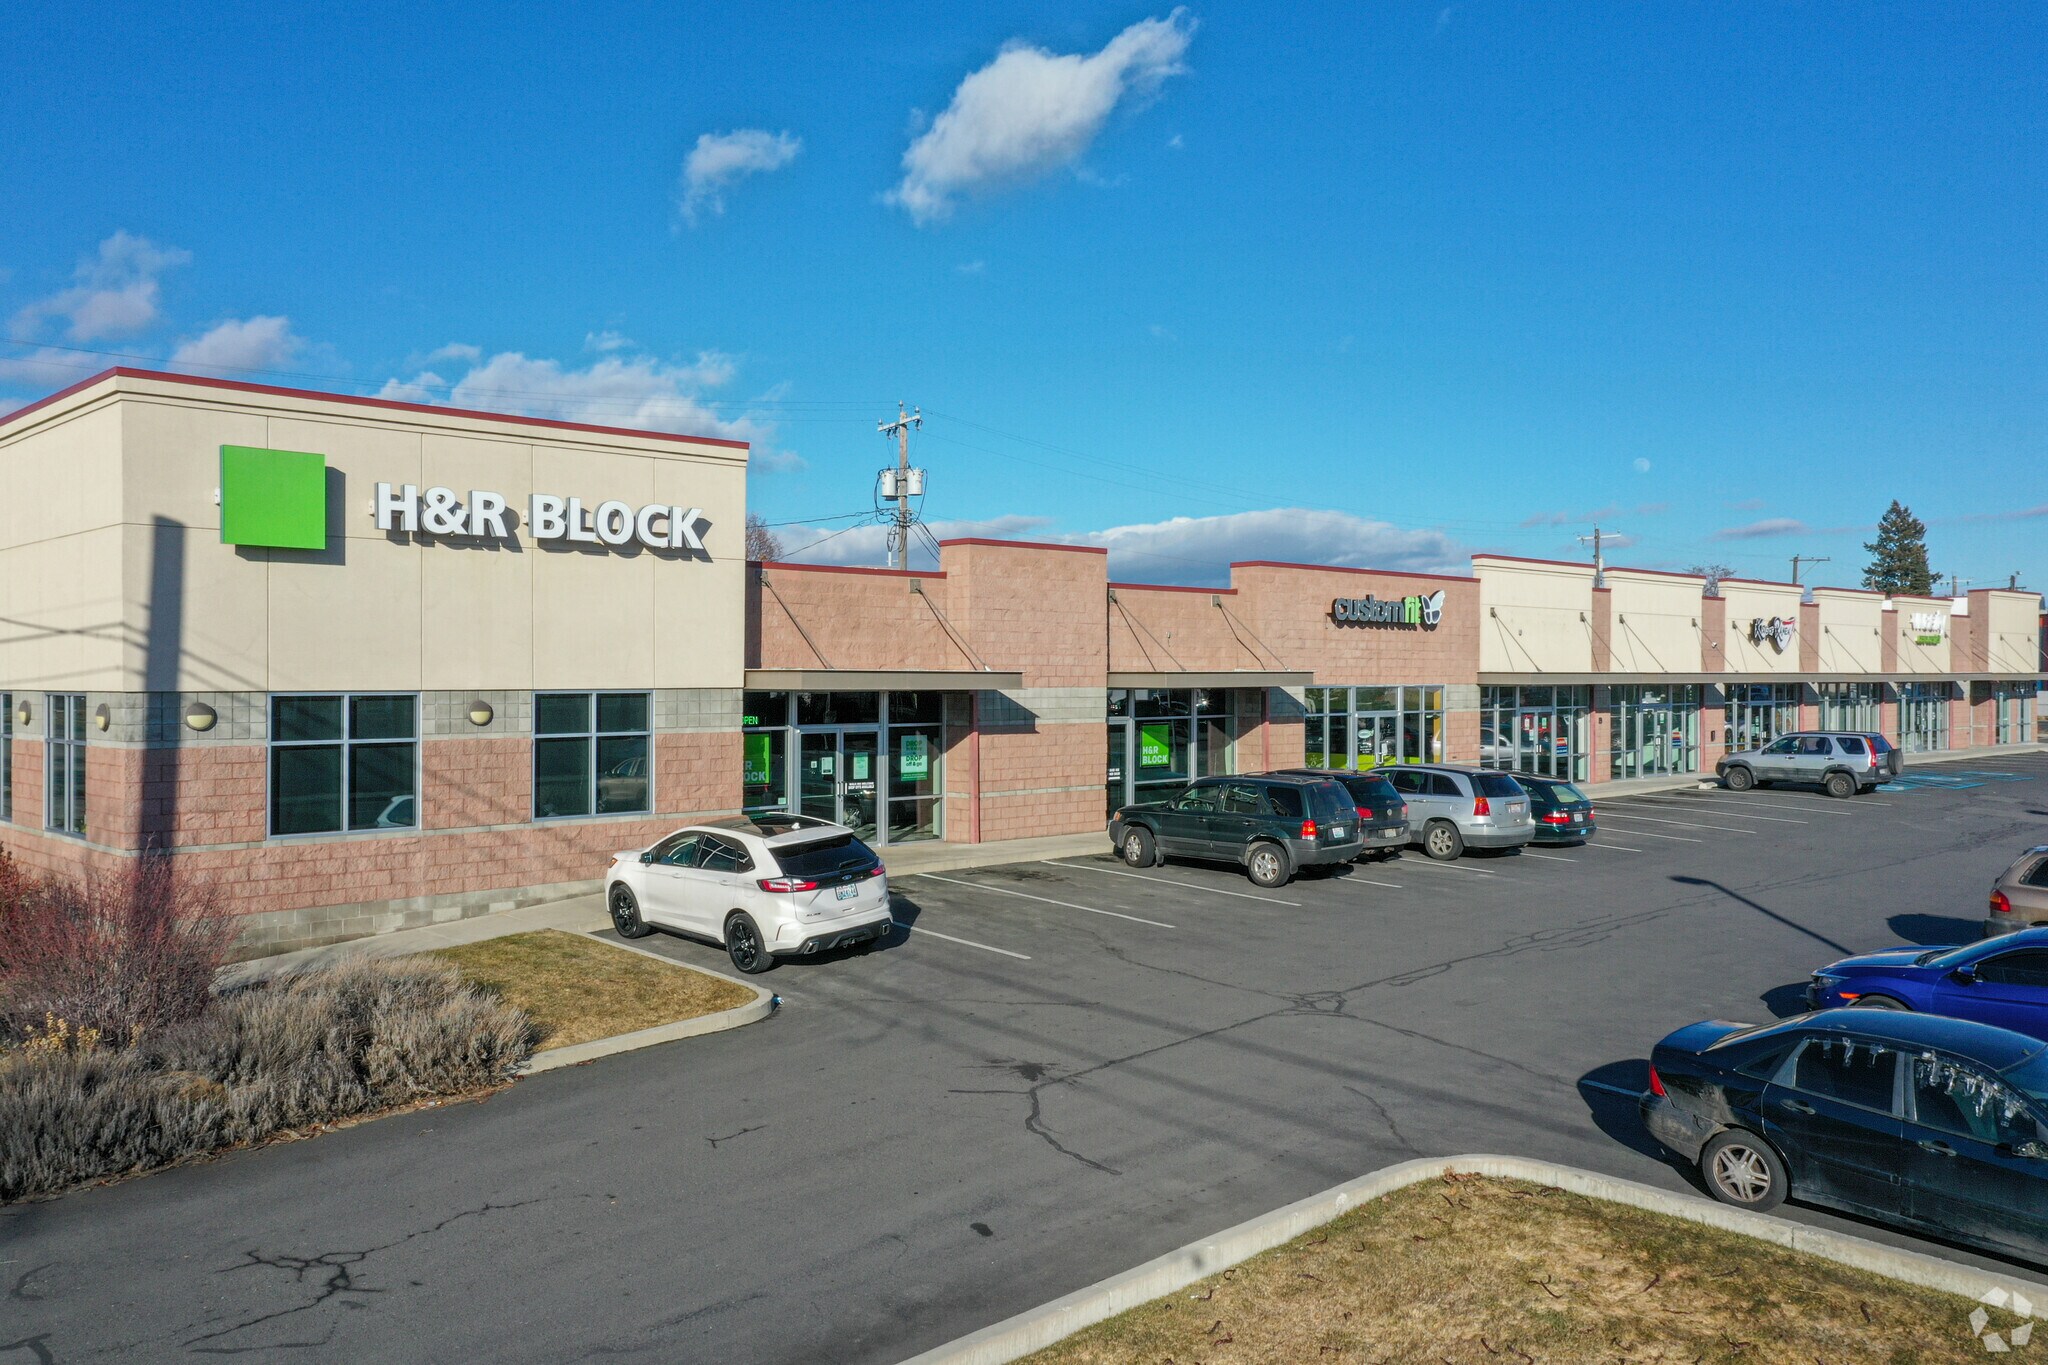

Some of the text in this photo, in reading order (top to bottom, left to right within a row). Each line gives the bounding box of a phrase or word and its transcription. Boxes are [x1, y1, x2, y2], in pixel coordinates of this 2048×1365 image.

[376, 482, 704, 549] H&R BLOCK
[1142, 746, 1159, 755] H&R
[1142, 755, 1169, 764] BLOCK
[743, 771, 766, 782] OCK
